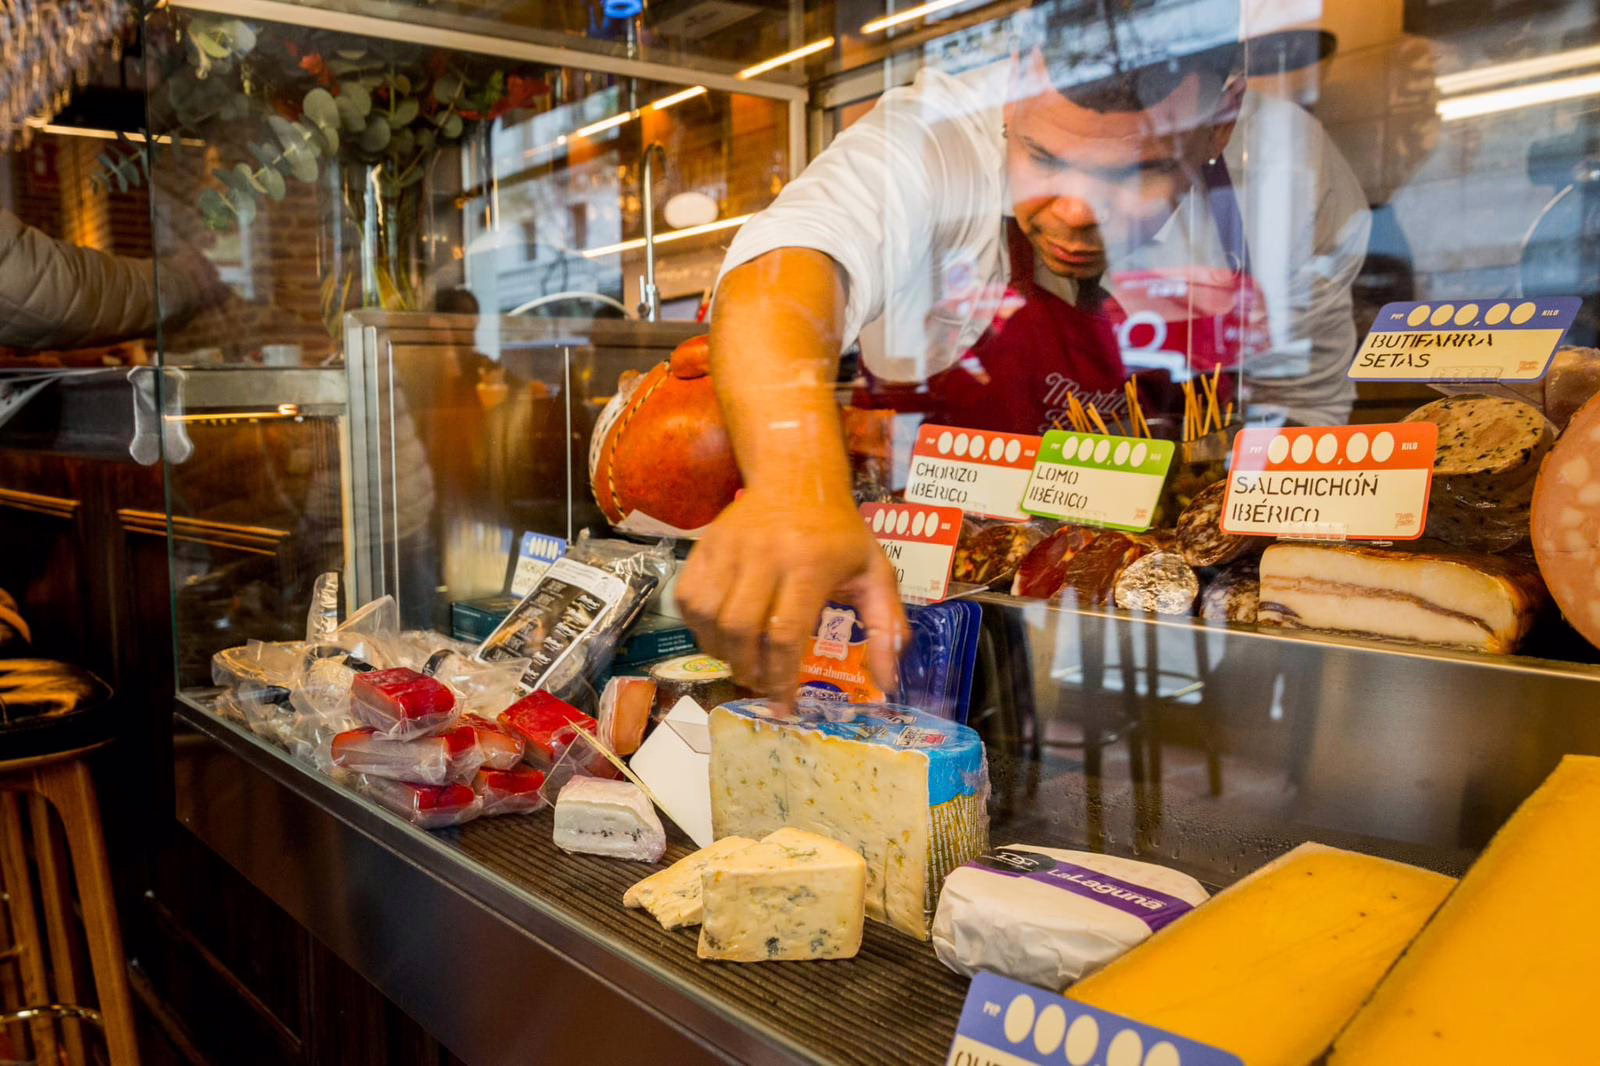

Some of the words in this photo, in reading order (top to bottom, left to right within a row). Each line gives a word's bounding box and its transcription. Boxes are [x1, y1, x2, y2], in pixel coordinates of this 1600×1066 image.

[1370, 332, 1493, 349] BUTIFARRA
[1359, 352, 1431, 368] SETAS
[1401, 442, 1419, 450] KILO
[916, 462, 978, 483] CHORIZO
[1036, 466, 1079, 485] LOMO
[911, 480, 968, 503] IBÉRICO
[1234, 472, 1379, 497] SALCHICHÓN
[1029, 484, 1088, 510] IBÉRICO
[1232, 499, 1320, 524] IBÉRICO
